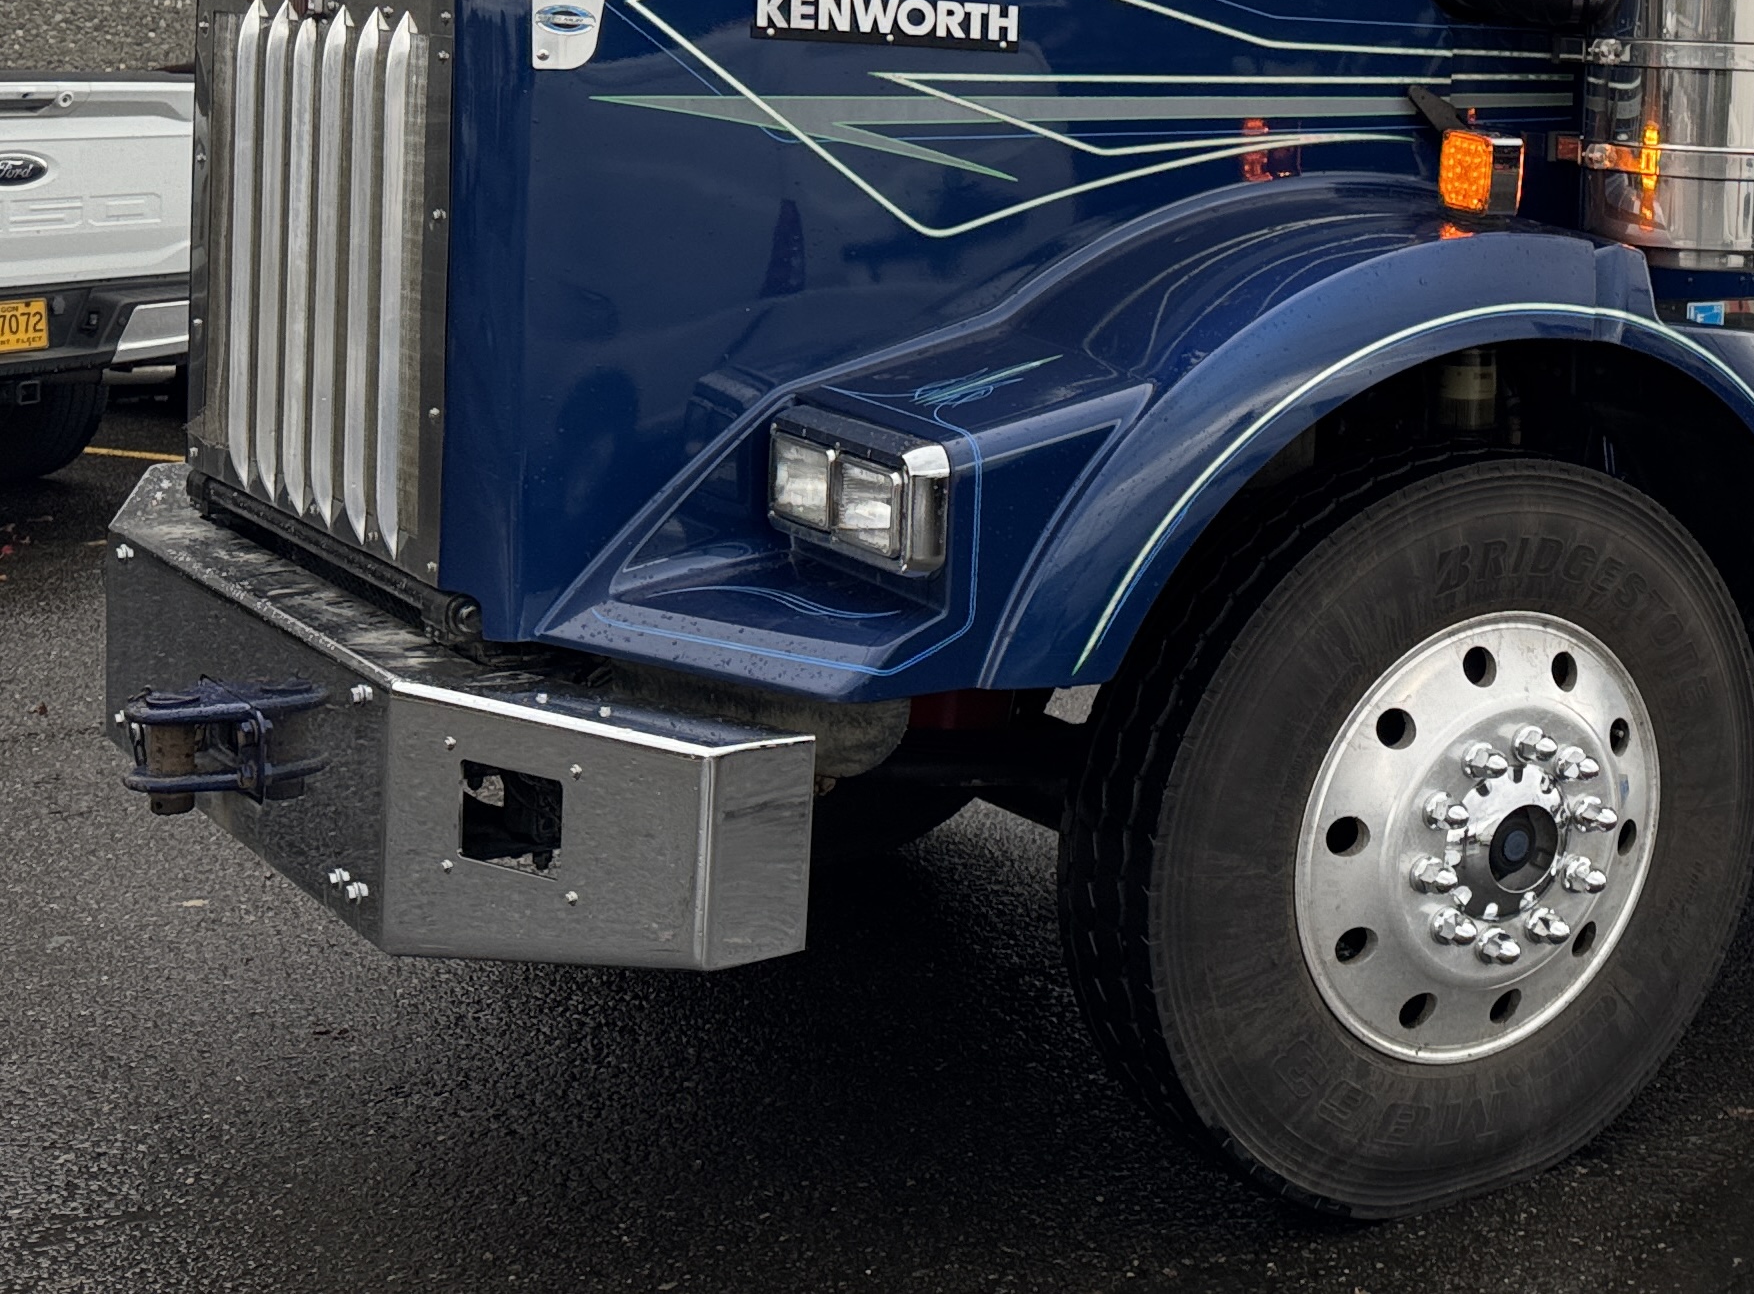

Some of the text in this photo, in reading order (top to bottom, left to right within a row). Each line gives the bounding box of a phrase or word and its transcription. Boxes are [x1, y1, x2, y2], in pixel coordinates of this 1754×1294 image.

[0, 160, 34, 179] Ford
[0, 192, 163, 233] 50
[0, 311, 44, 337] 7072
[1434, 535, 1714, 706] BRIDGESTONE
